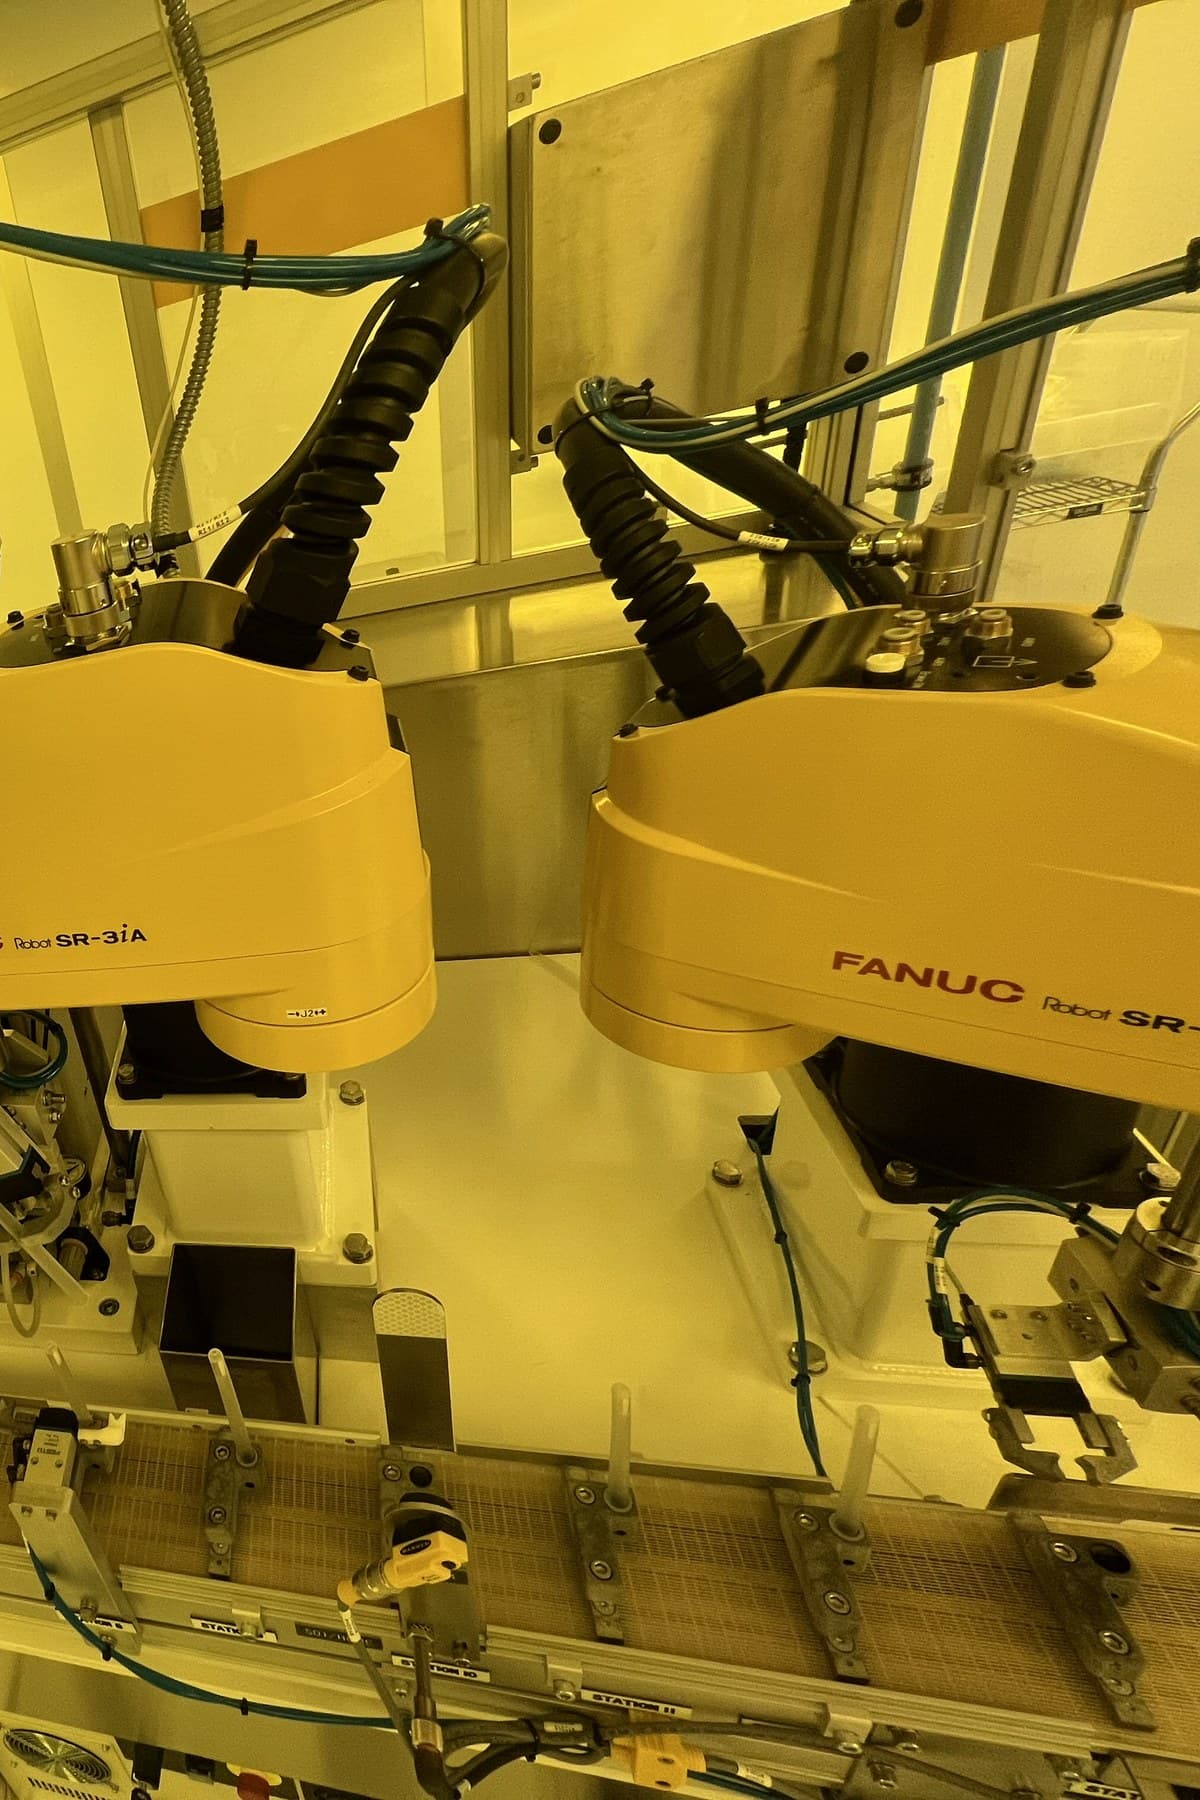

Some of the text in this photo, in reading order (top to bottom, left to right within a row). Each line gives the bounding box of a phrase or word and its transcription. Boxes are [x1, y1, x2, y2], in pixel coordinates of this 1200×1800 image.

[14, 937, 52, 950] Robot
[55, 923, 148, 948] SR-3iA
[831, 950, 1025, 1004] FANUC
[1042, 996, 1113, 1021] Robot
[593, 1693, 660, 1712] STATION
